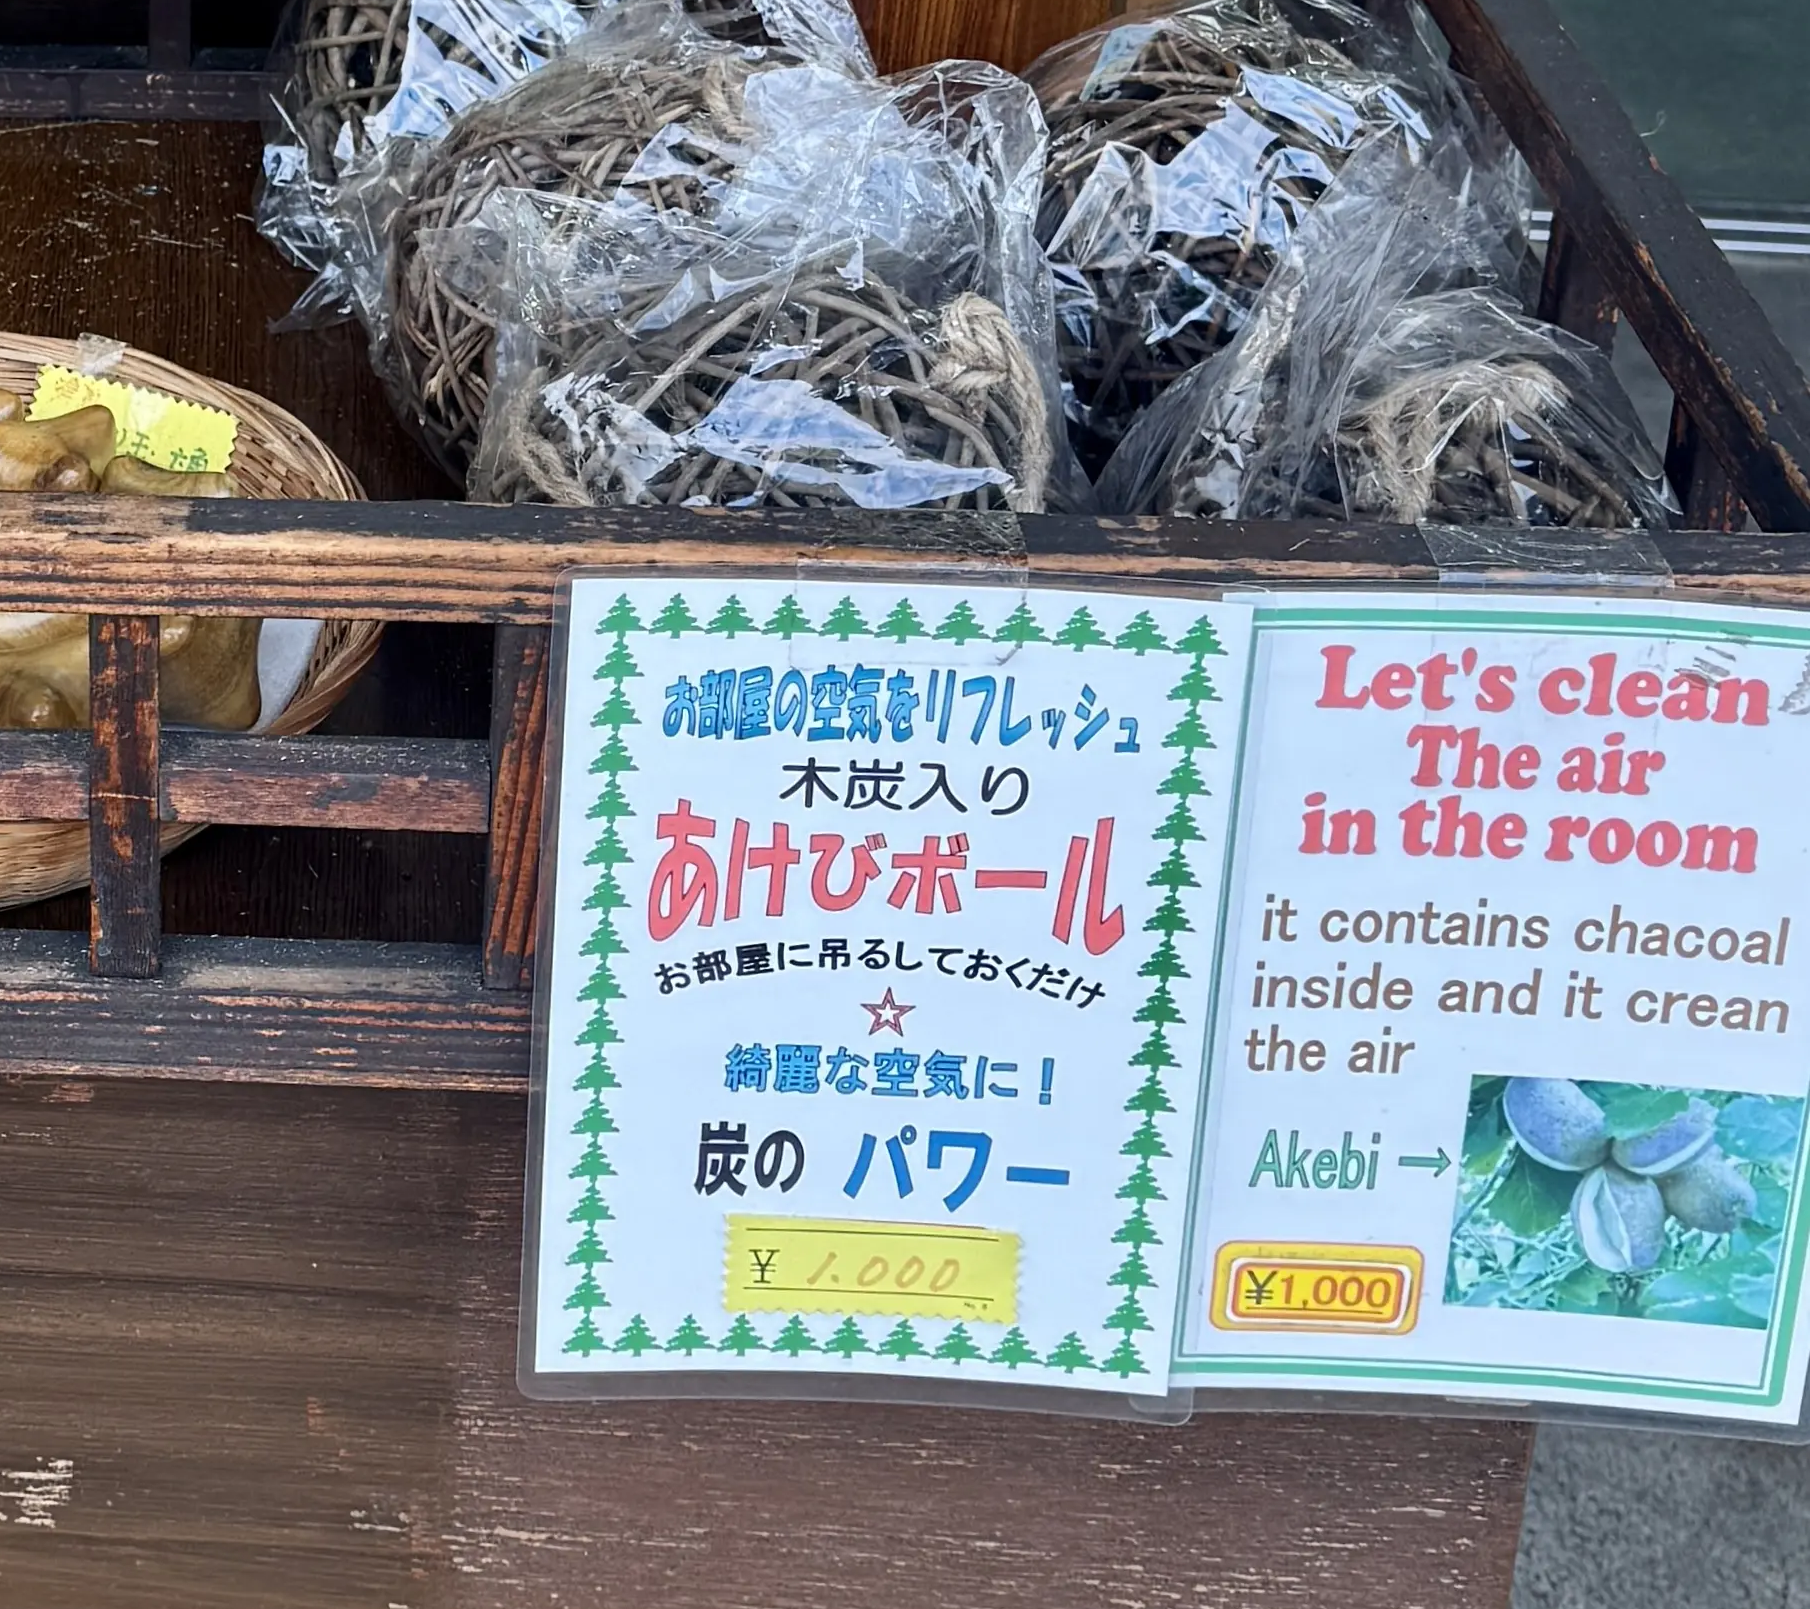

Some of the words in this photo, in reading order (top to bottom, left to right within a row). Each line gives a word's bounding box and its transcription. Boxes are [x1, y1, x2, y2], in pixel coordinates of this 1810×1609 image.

[661, 663, 1141, 754] お部屋の空気をリフレッシュ
[1314, 643, 1518, 714] Let's
[1537, 651, 1771, 727] clean
[778, 756, 1030, 816] 木炭入り
[1405, 724, 1541, 790] The
[1555, 731, 1667, 796] air
[1297, 791, 1378, 856] in
[1397, 794, 1529, 860] the
[1543, 812, 1761, 874] room
[647, 797, 1126, 956] あけびボール
[1261, 892, 1300, 943] it
[1318, 897, 1551, 950] contains
[1573, 903, 1792, 967] chacoal
[653, 937, 1107, 1010] お部屋に吊るしておくだけ
[1251, 960, 1414, 1010] inside
[1436, 967, 1543, 1017] and
[1563, 970, 1605, 1020] it
[1625, 988, 1792, 1034] crean
[1244, 1023, 1327, 1073] the
[1347, 1025, 1416, 1075] air
[693, 1120, 806, 1197] 炭の
[842, 1124, 1071, 1213] パワー
[1247, 1128, 1382, 1191] Akebi
[1244, 1270, 1392, 1311] ¥1,000
